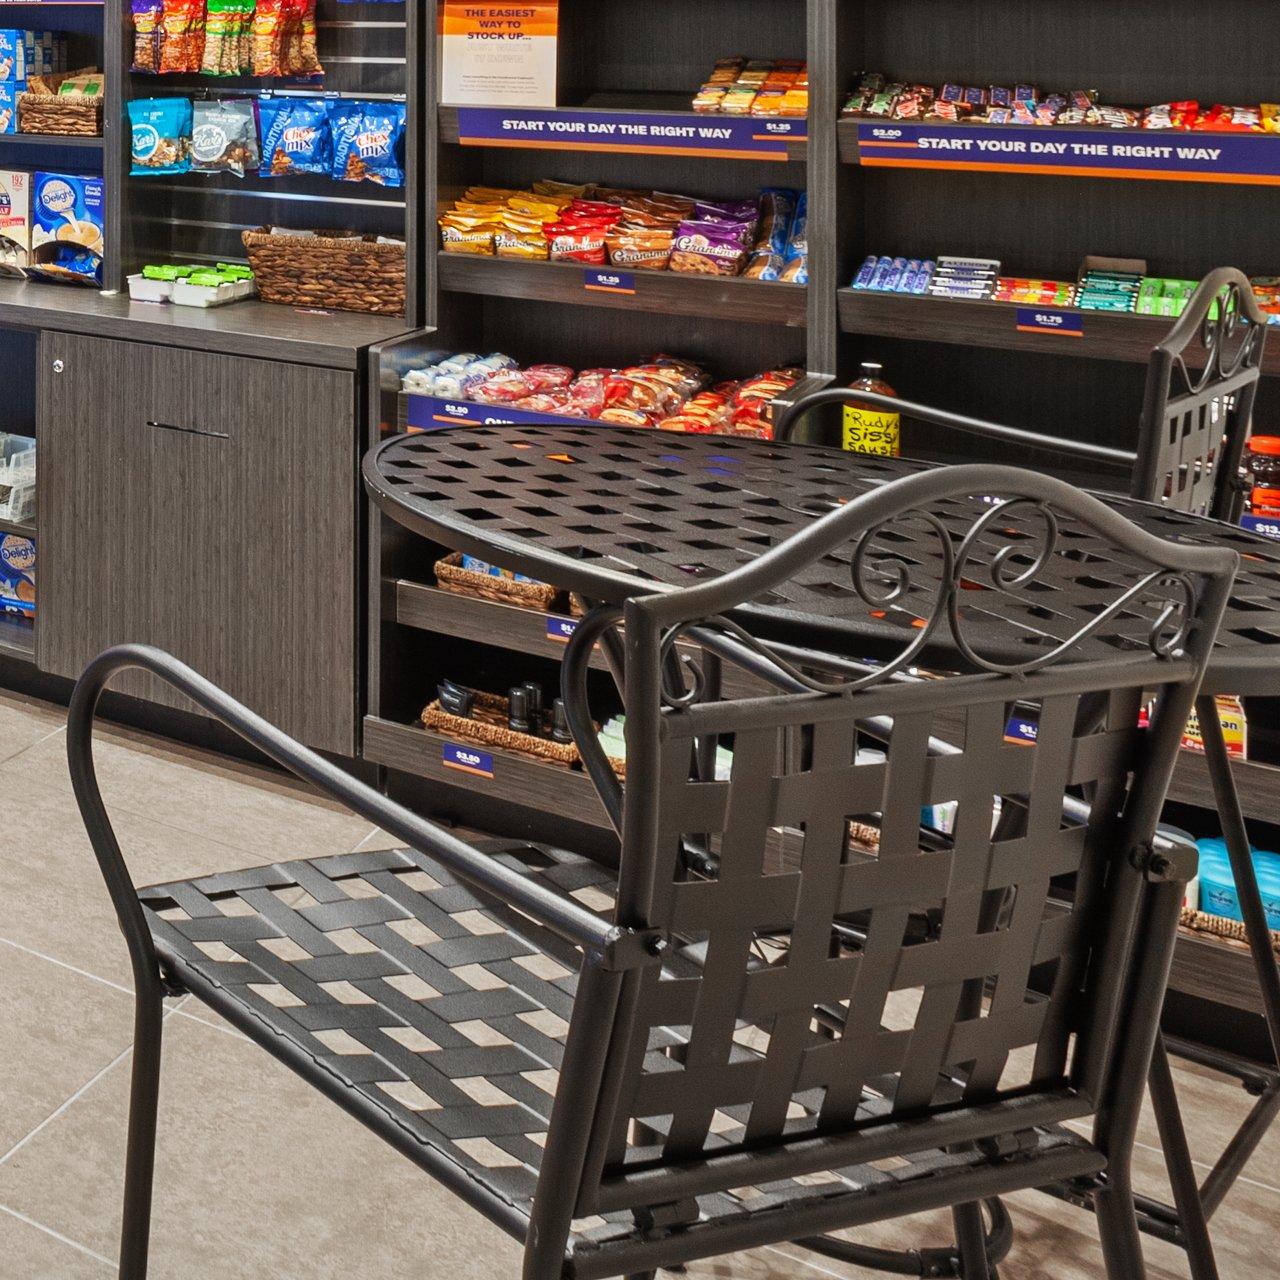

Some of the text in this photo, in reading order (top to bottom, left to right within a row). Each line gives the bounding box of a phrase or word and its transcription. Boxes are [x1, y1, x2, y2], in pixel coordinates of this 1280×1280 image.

[465, 9, 536, 18] THE EASIEST
[479, 20, 521, 29] WAY TO
[467, 32, 532, 40] STOCK UP...
[262, 106, 291, 164] TRADITIONAL
[284, 127, 314, 142] Chex
[502, 120, 732, 139] START YOUR DAY THE RIGHT WAY
[872, 128, 902, 138] $2.00
[286, 139, 312, 152] mix
[357, 131, 387, 146] Chex
[360, 144, 387, 158] mix
[917, 137, 1222, 161] START YOUR DAY THE RIGHT WAY
[11, 174, 23, 187] 192
[43, 188, 75, 205] Delight
[1034, 314, 1063, 324] $1.75
[1, 546, 36, 560] Delight
